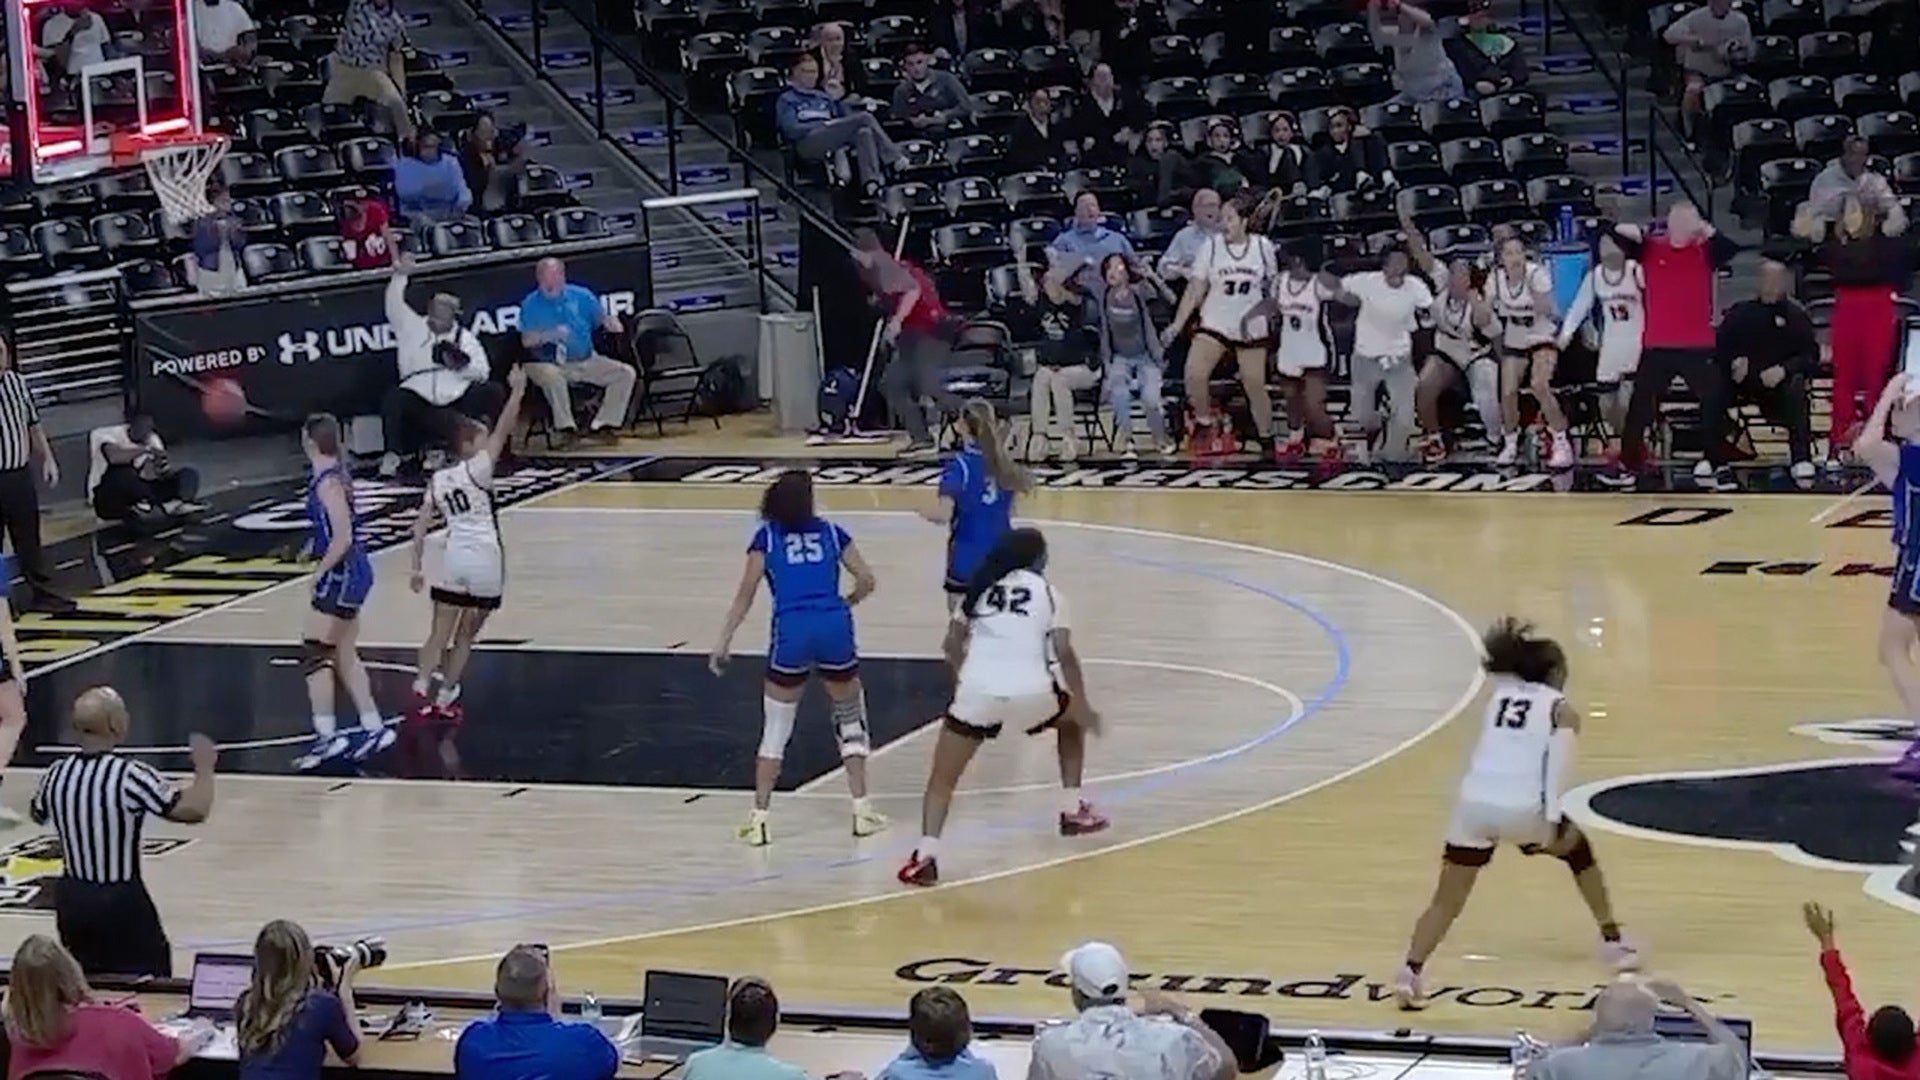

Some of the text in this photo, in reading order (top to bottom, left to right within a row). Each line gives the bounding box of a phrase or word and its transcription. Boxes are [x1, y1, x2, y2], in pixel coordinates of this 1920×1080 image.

[152, 348, 243, 376] POWERED
[326, 321, 400, 357] UND
[680, 464, 1550, 491] GSHKERS.COM
[443, 487, 472, 517] 10
[784, 531, 824, 565] 25
[985, 583, 1034, 618] 42
[1494, 696, 1532, 730] 13
[894, 956, 1716, 1012] Grundwor
